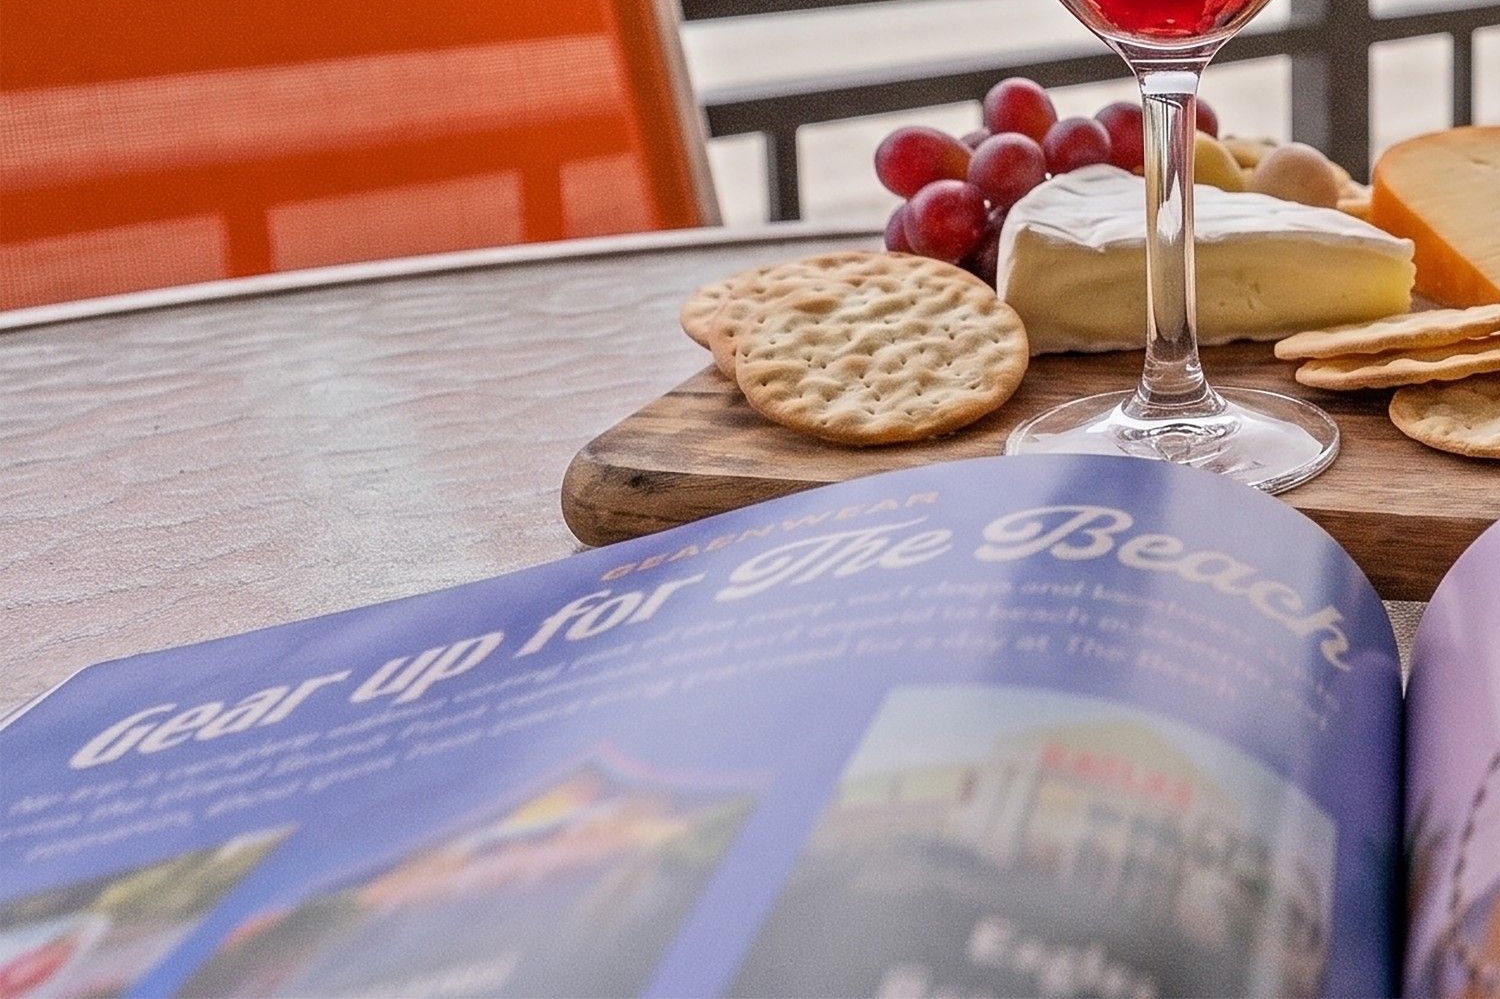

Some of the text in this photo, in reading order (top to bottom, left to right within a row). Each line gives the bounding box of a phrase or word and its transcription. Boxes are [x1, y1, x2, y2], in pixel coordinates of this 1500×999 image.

[68, 670, 352, 770] Gear
[349, 631, 504, 702] up
[514, 574, 706, 657] for
[715, 516, 953, 602] The
[974, 504, 1354, 671] Beach
